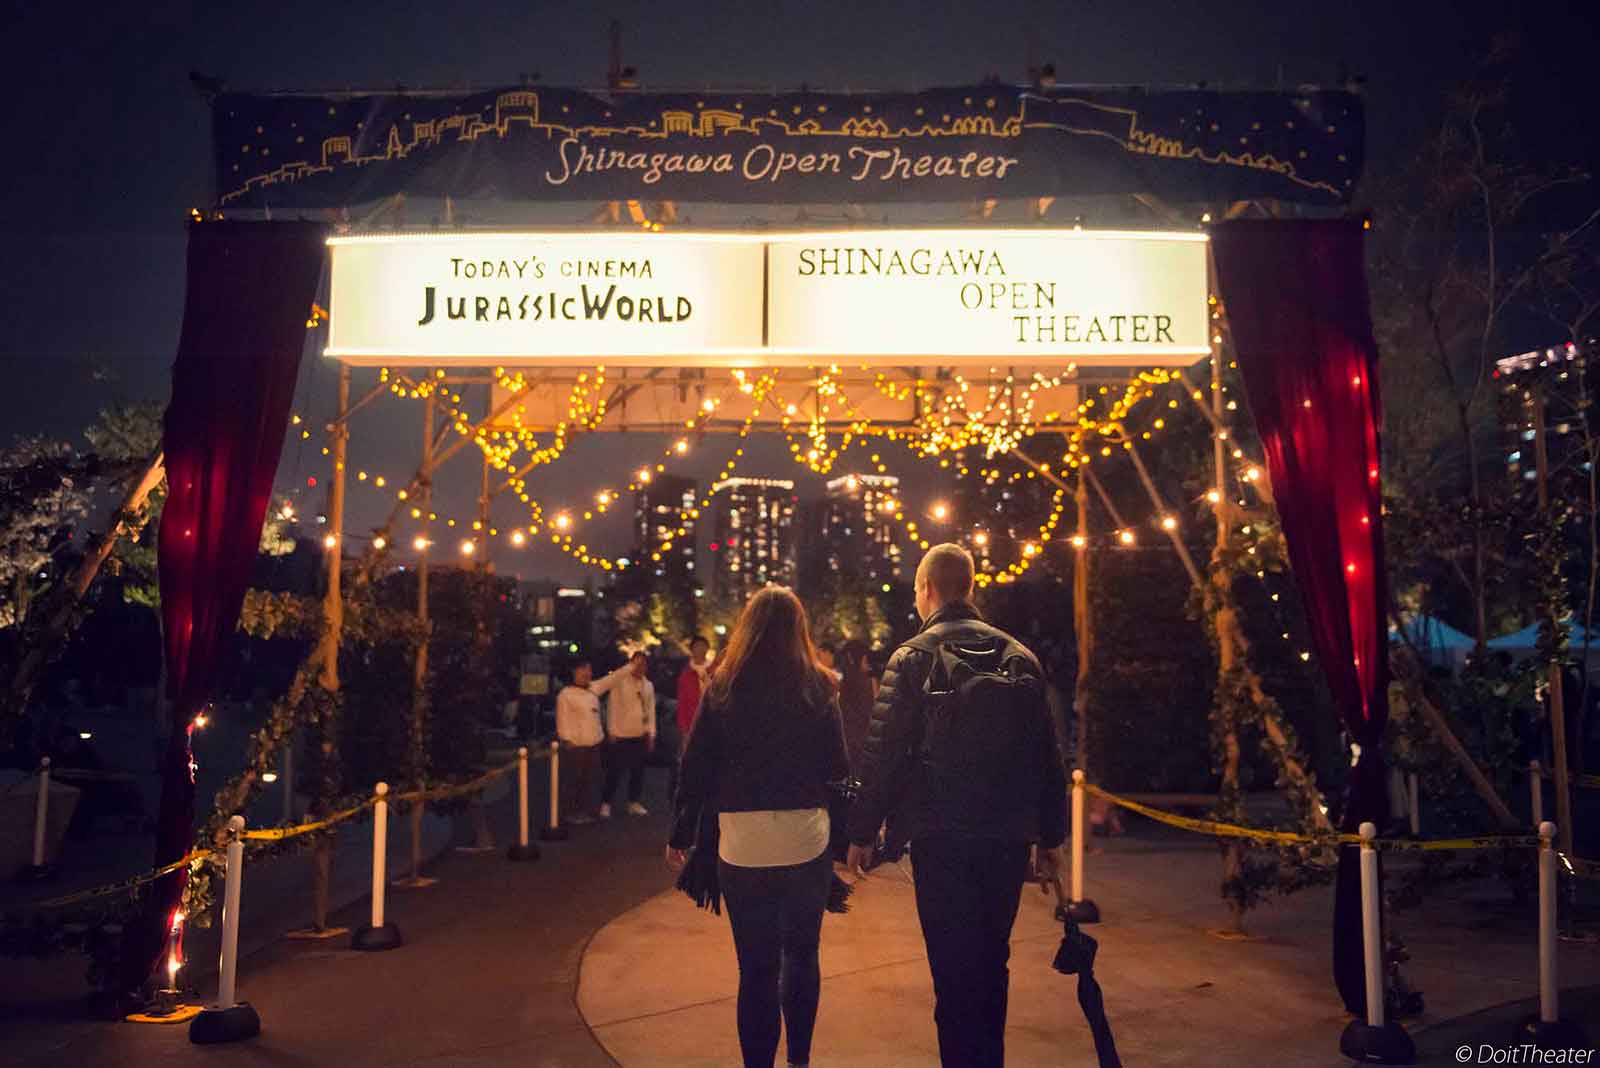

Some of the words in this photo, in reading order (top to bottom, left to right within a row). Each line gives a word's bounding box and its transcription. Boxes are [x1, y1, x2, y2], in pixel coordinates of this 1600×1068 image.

[545, 137, 733, 185] Shinagawa
[742, 143, 842, 184] Open
[849, 146, 1019, 181] Theater
[560, 259, 653, 279] CINEMA
[798, 248, 1007, 276] SHINAGAWA
[960, 282, 1057, 310] OPEN
[1013, 315, 1176, 343] THEATER
